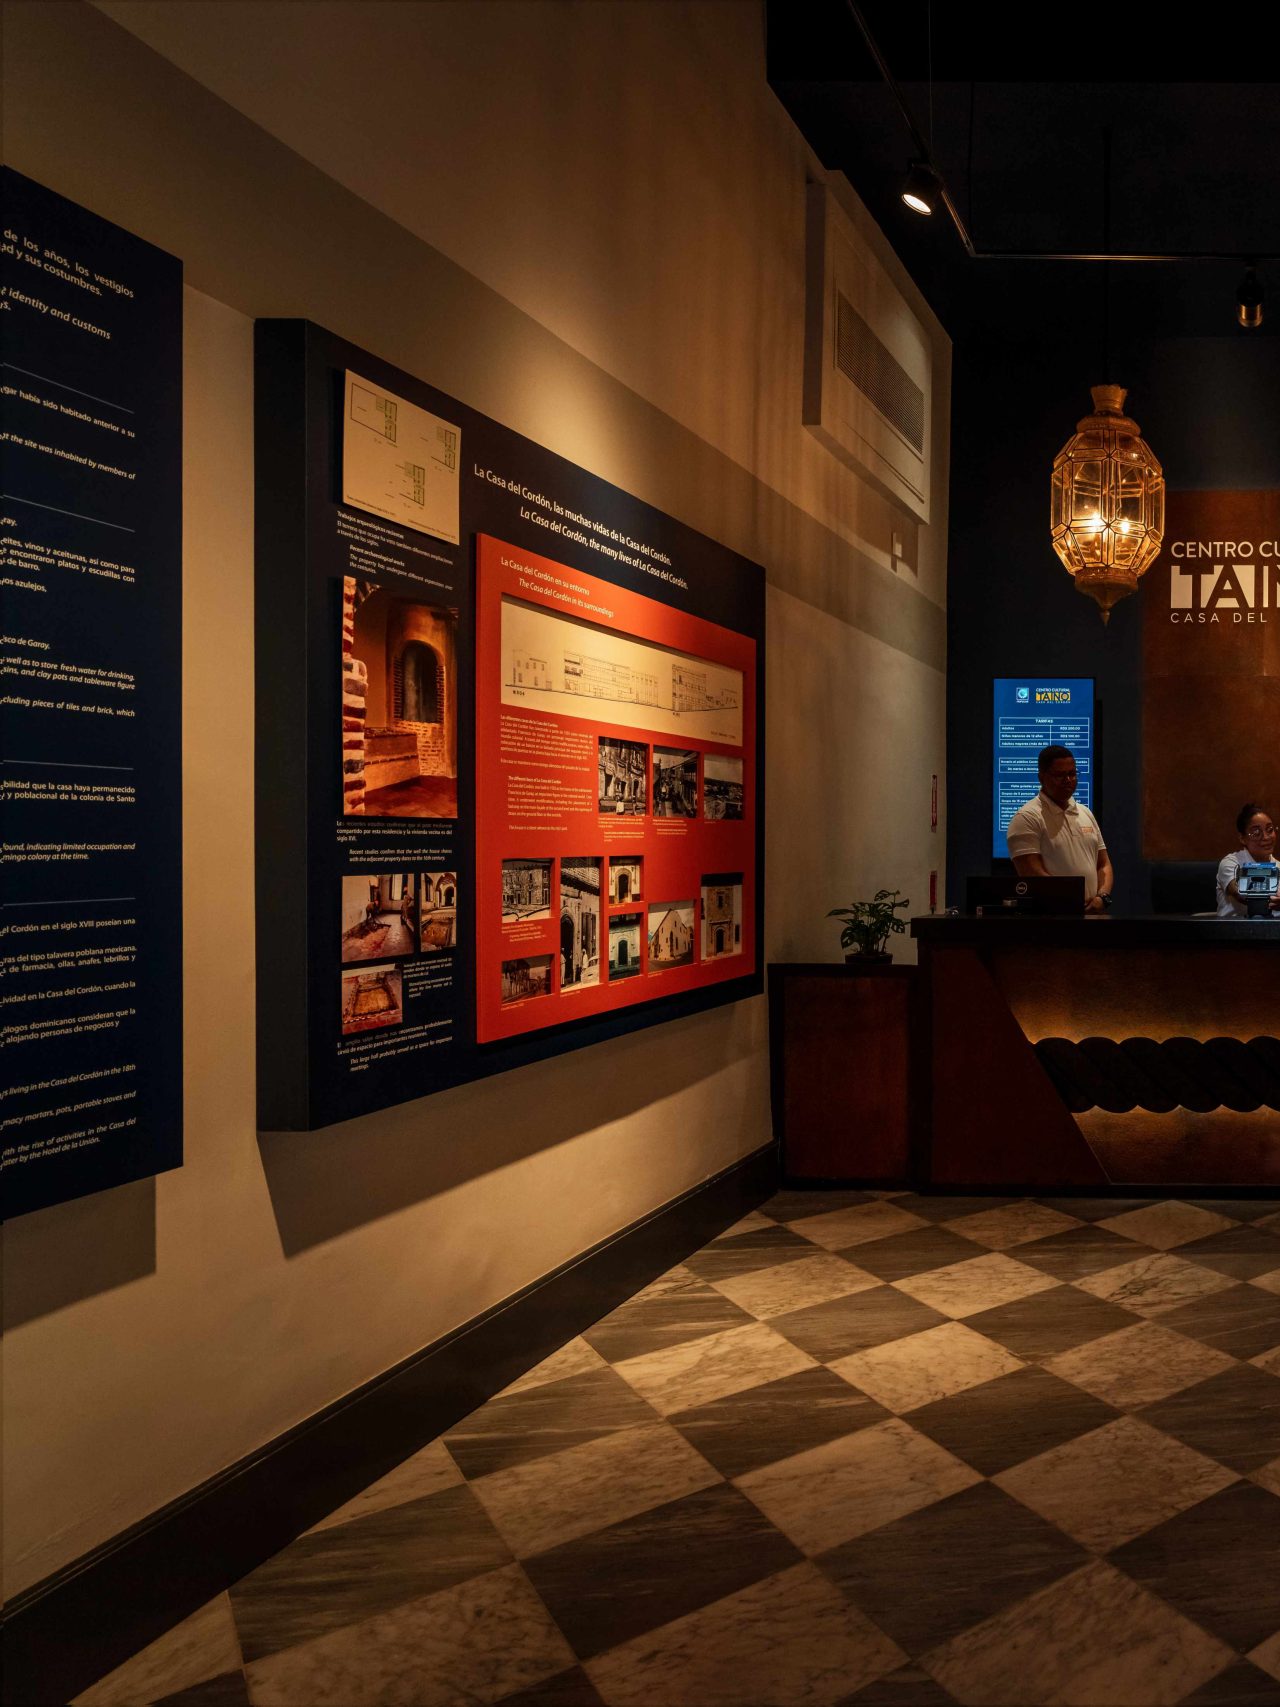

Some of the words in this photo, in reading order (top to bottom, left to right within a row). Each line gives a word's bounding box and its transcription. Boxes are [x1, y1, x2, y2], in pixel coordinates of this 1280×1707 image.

[4, 229, 18, 242] de
[24, 237, 39, 252] los
[44, 249, 70, 268] años,
[75, 262, 90, 277] los
[94, 273, 134, 298] vestigios
[9, 288, 48, 313] identity
[50, 308, 71, 322] and
[72, 317, 110, 339] customs
[474, 463, 485, 478] La
[486, 470, 506, 488] Casa
[507, 480, 521, 495] del
[522, 487, 553, 511] Cordón,
[553, 501, 564, 515] las
[565, 509, 592, 529] muchas
[592, 522, 610, 537] vidas
[610, 529, 619, 541] de
[619, 532, 626, 544] la
[626, 536, 640, 551] Casa
[640, 543, 650, 556] del
[650, 548, 672, 566] Cordón.
[520, 506, 530, 520] La
[531, 511, 549, 528] Casa
[549, 520, 562, 533] del
[562, 525, 589, 547] Cordón,
[589, 538, 600, 551] the
[600, 545, 618, 560] many
[618, 550, 632, 565] lives
[632, 558, 640, 569] of
[639, 560, 647, 571] La
[646, 563, 660, 577] Casa
[660, 570, 669, 581] del
[668, 573, 688, 589] Cordón.
[1170, 541, 1254, 558] CENTRO
[1170, 612, 1220, 624] CASA
[1233, 612, 1267, 623] DEL
